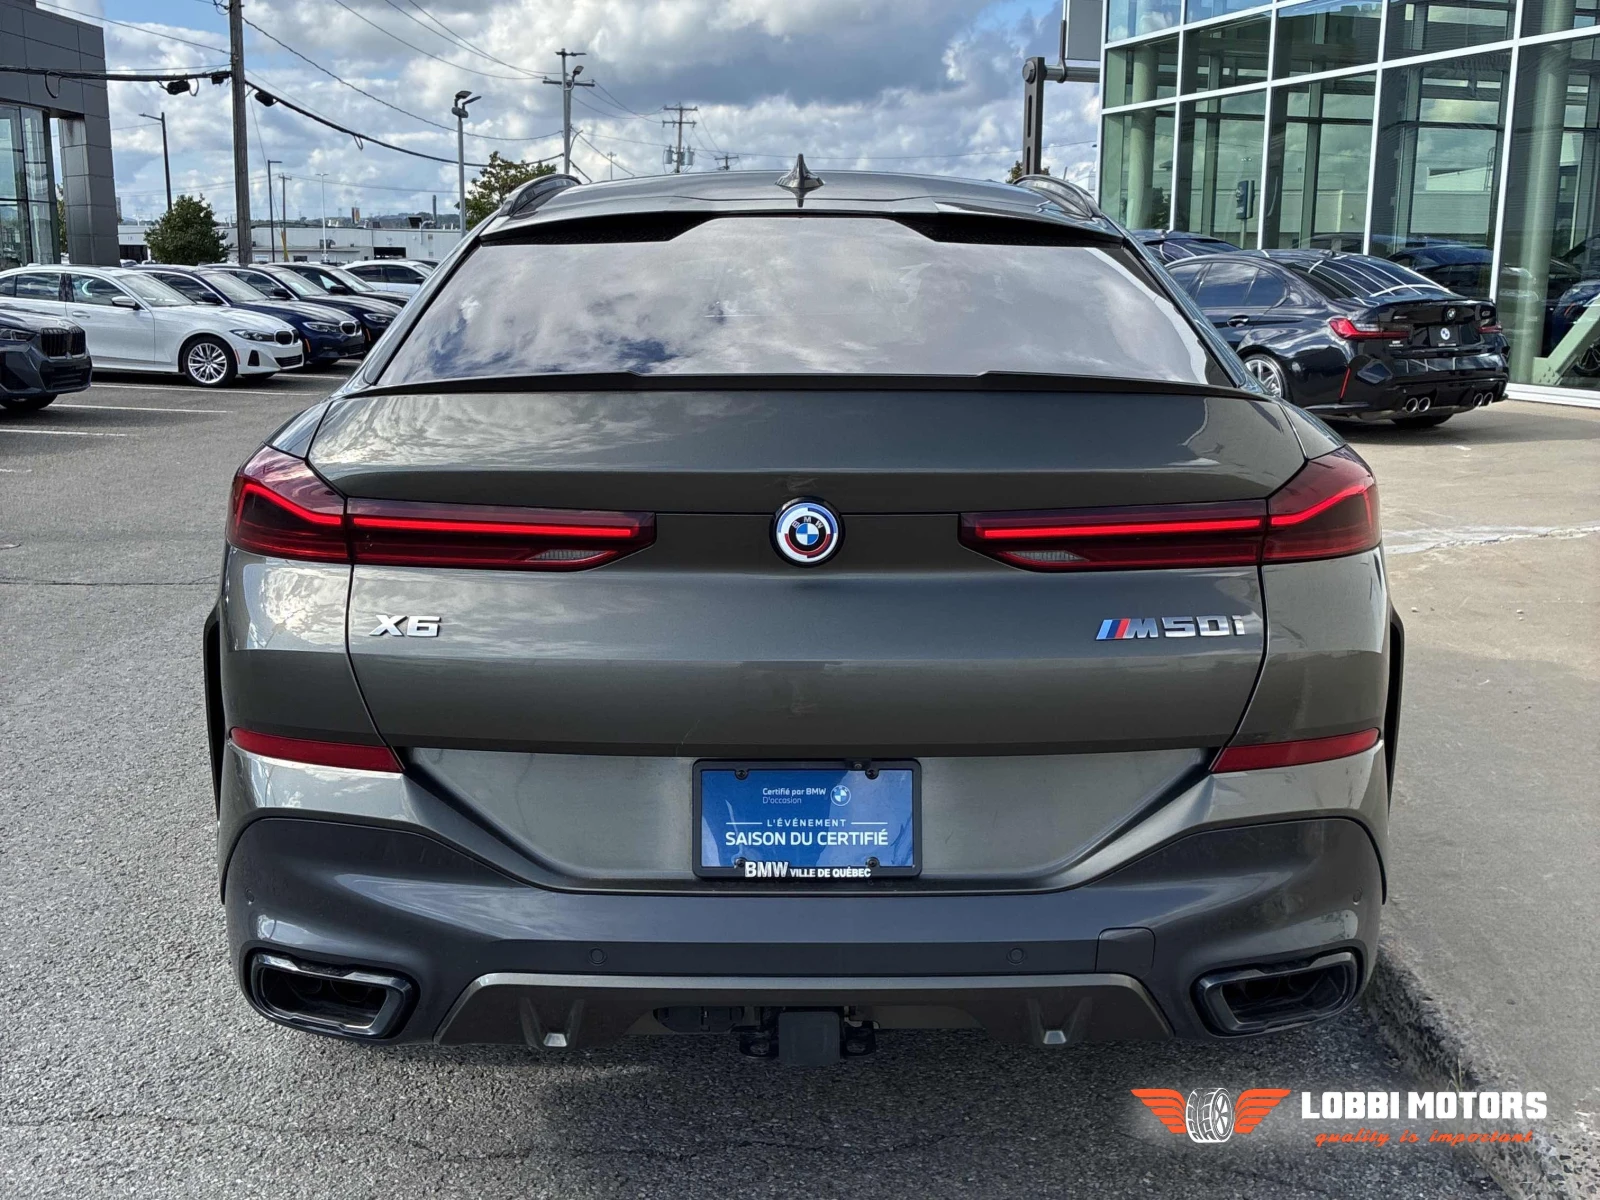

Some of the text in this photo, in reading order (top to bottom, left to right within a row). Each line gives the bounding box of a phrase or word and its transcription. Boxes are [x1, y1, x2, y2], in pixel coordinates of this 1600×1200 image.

[791, 516, 824, 529] BMW
[368, 614, 441, 637] X6
[1122, 614, 1246, 639] M50i
[762, 787, 790, 796] Certifié
[791, 788, 805, 797] par
[805, 787, 827, 796] BMW
[762, 796, 802, 804] D'occasion
[766, 817, 847, 827] L'ÉVÉNEMENT
[725, 829, 889, 846] SAISON DU CERTIFIÉ
[744, 861, 872, 878] BMW VILLE DE QUÉBEC
